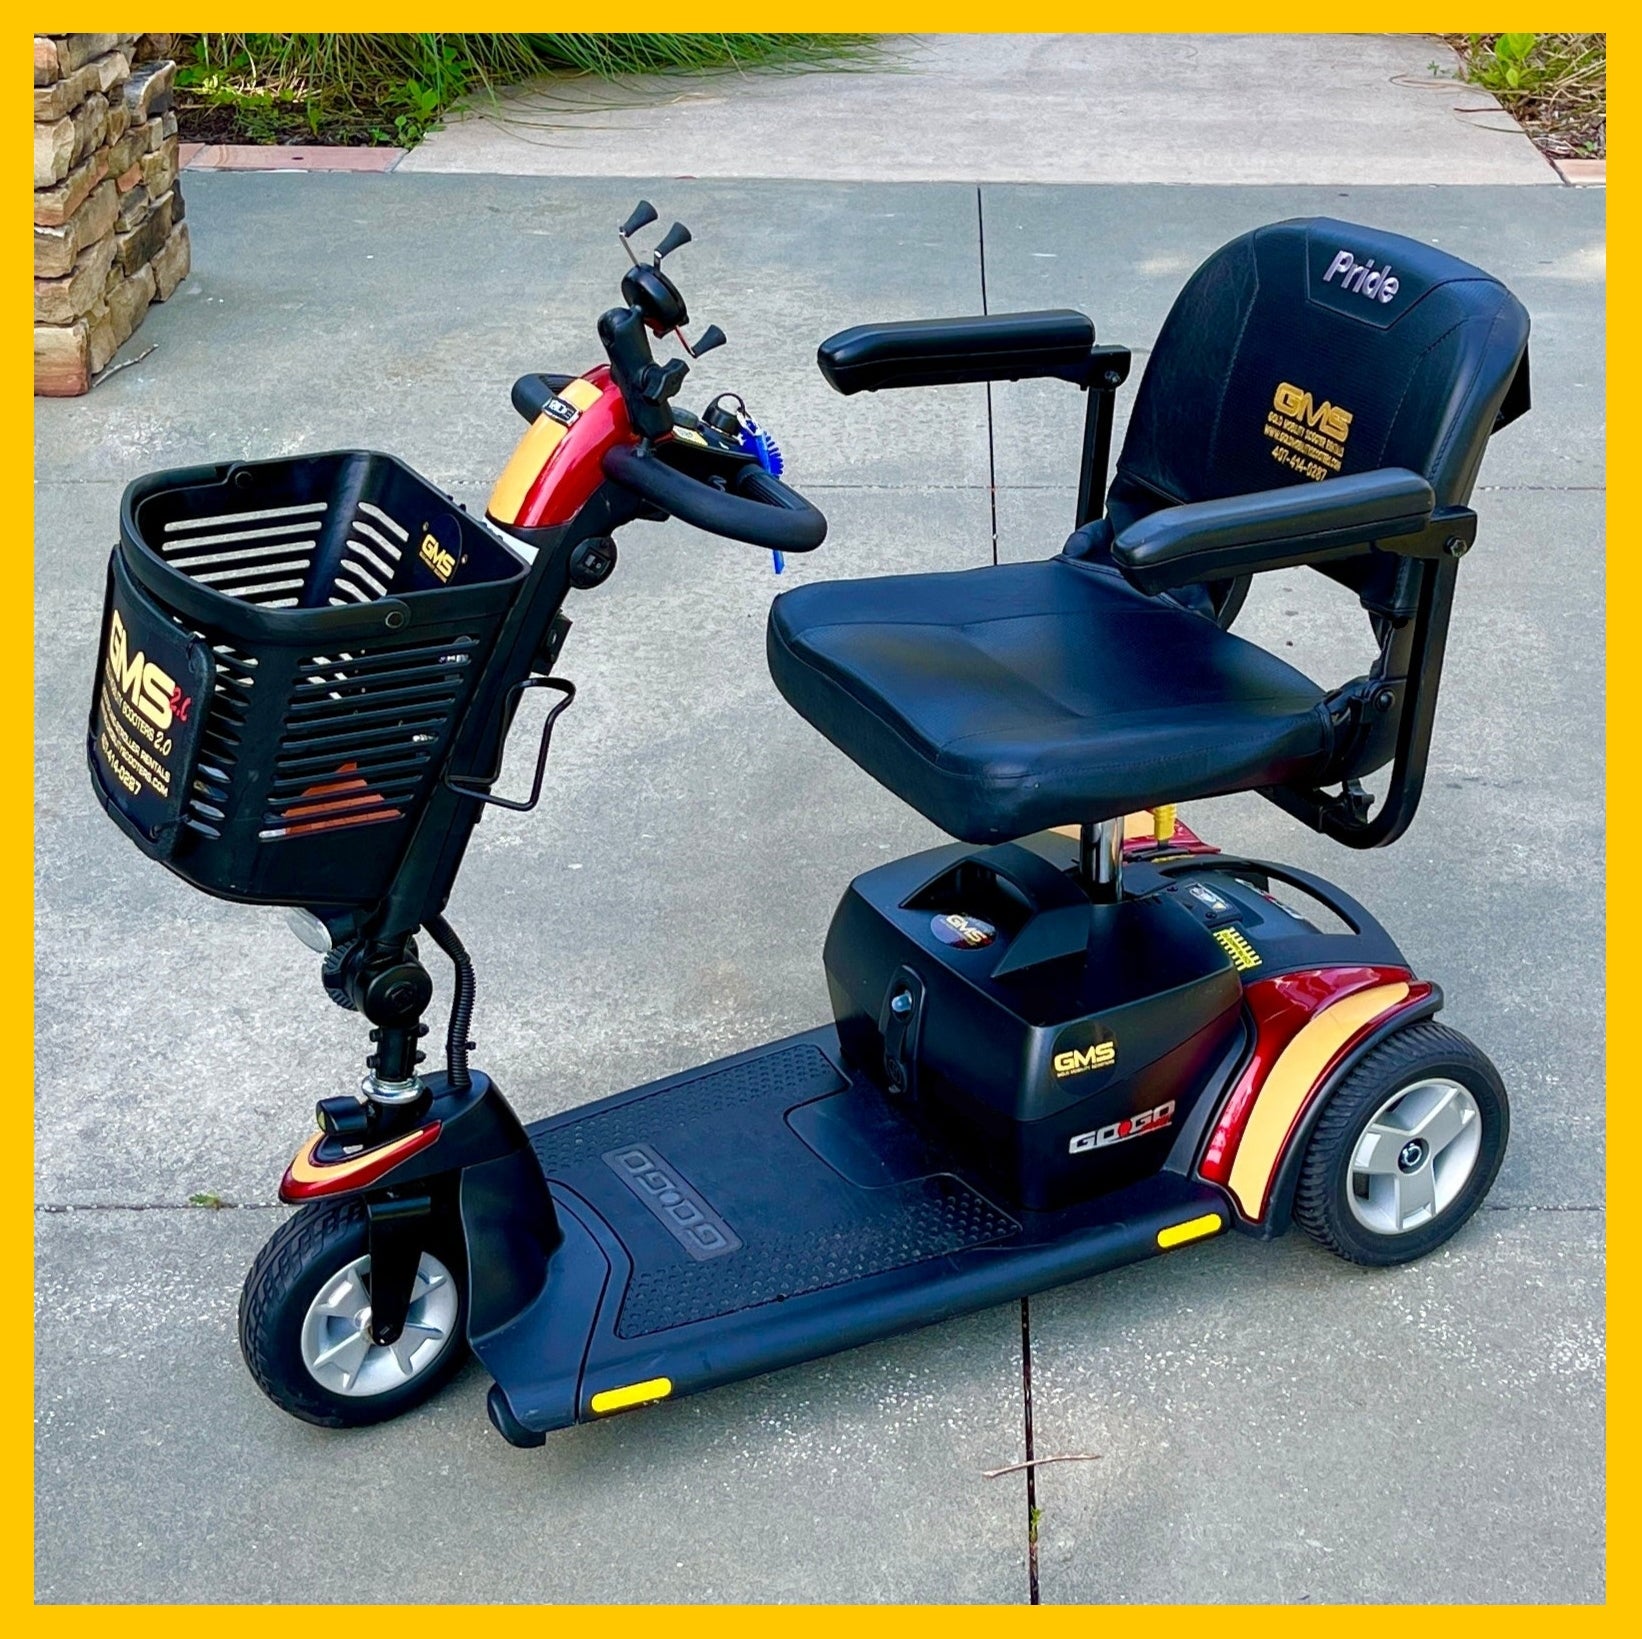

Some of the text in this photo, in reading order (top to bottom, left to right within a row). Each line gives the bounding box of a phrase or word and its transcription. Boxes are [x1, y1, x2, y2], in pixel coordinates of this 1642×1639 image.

[1323, 250, 1399, 303] Pride
[1273, 382, 1353, 442] GMS
[422, 533, 455, 577] GMS
[110, 609, 176, 730] GMS
[153, 730, 172, 756] 2.0
[140, 749, 171, 783] RENTALS
[1054, 1041, 1115, 1073] GMS
